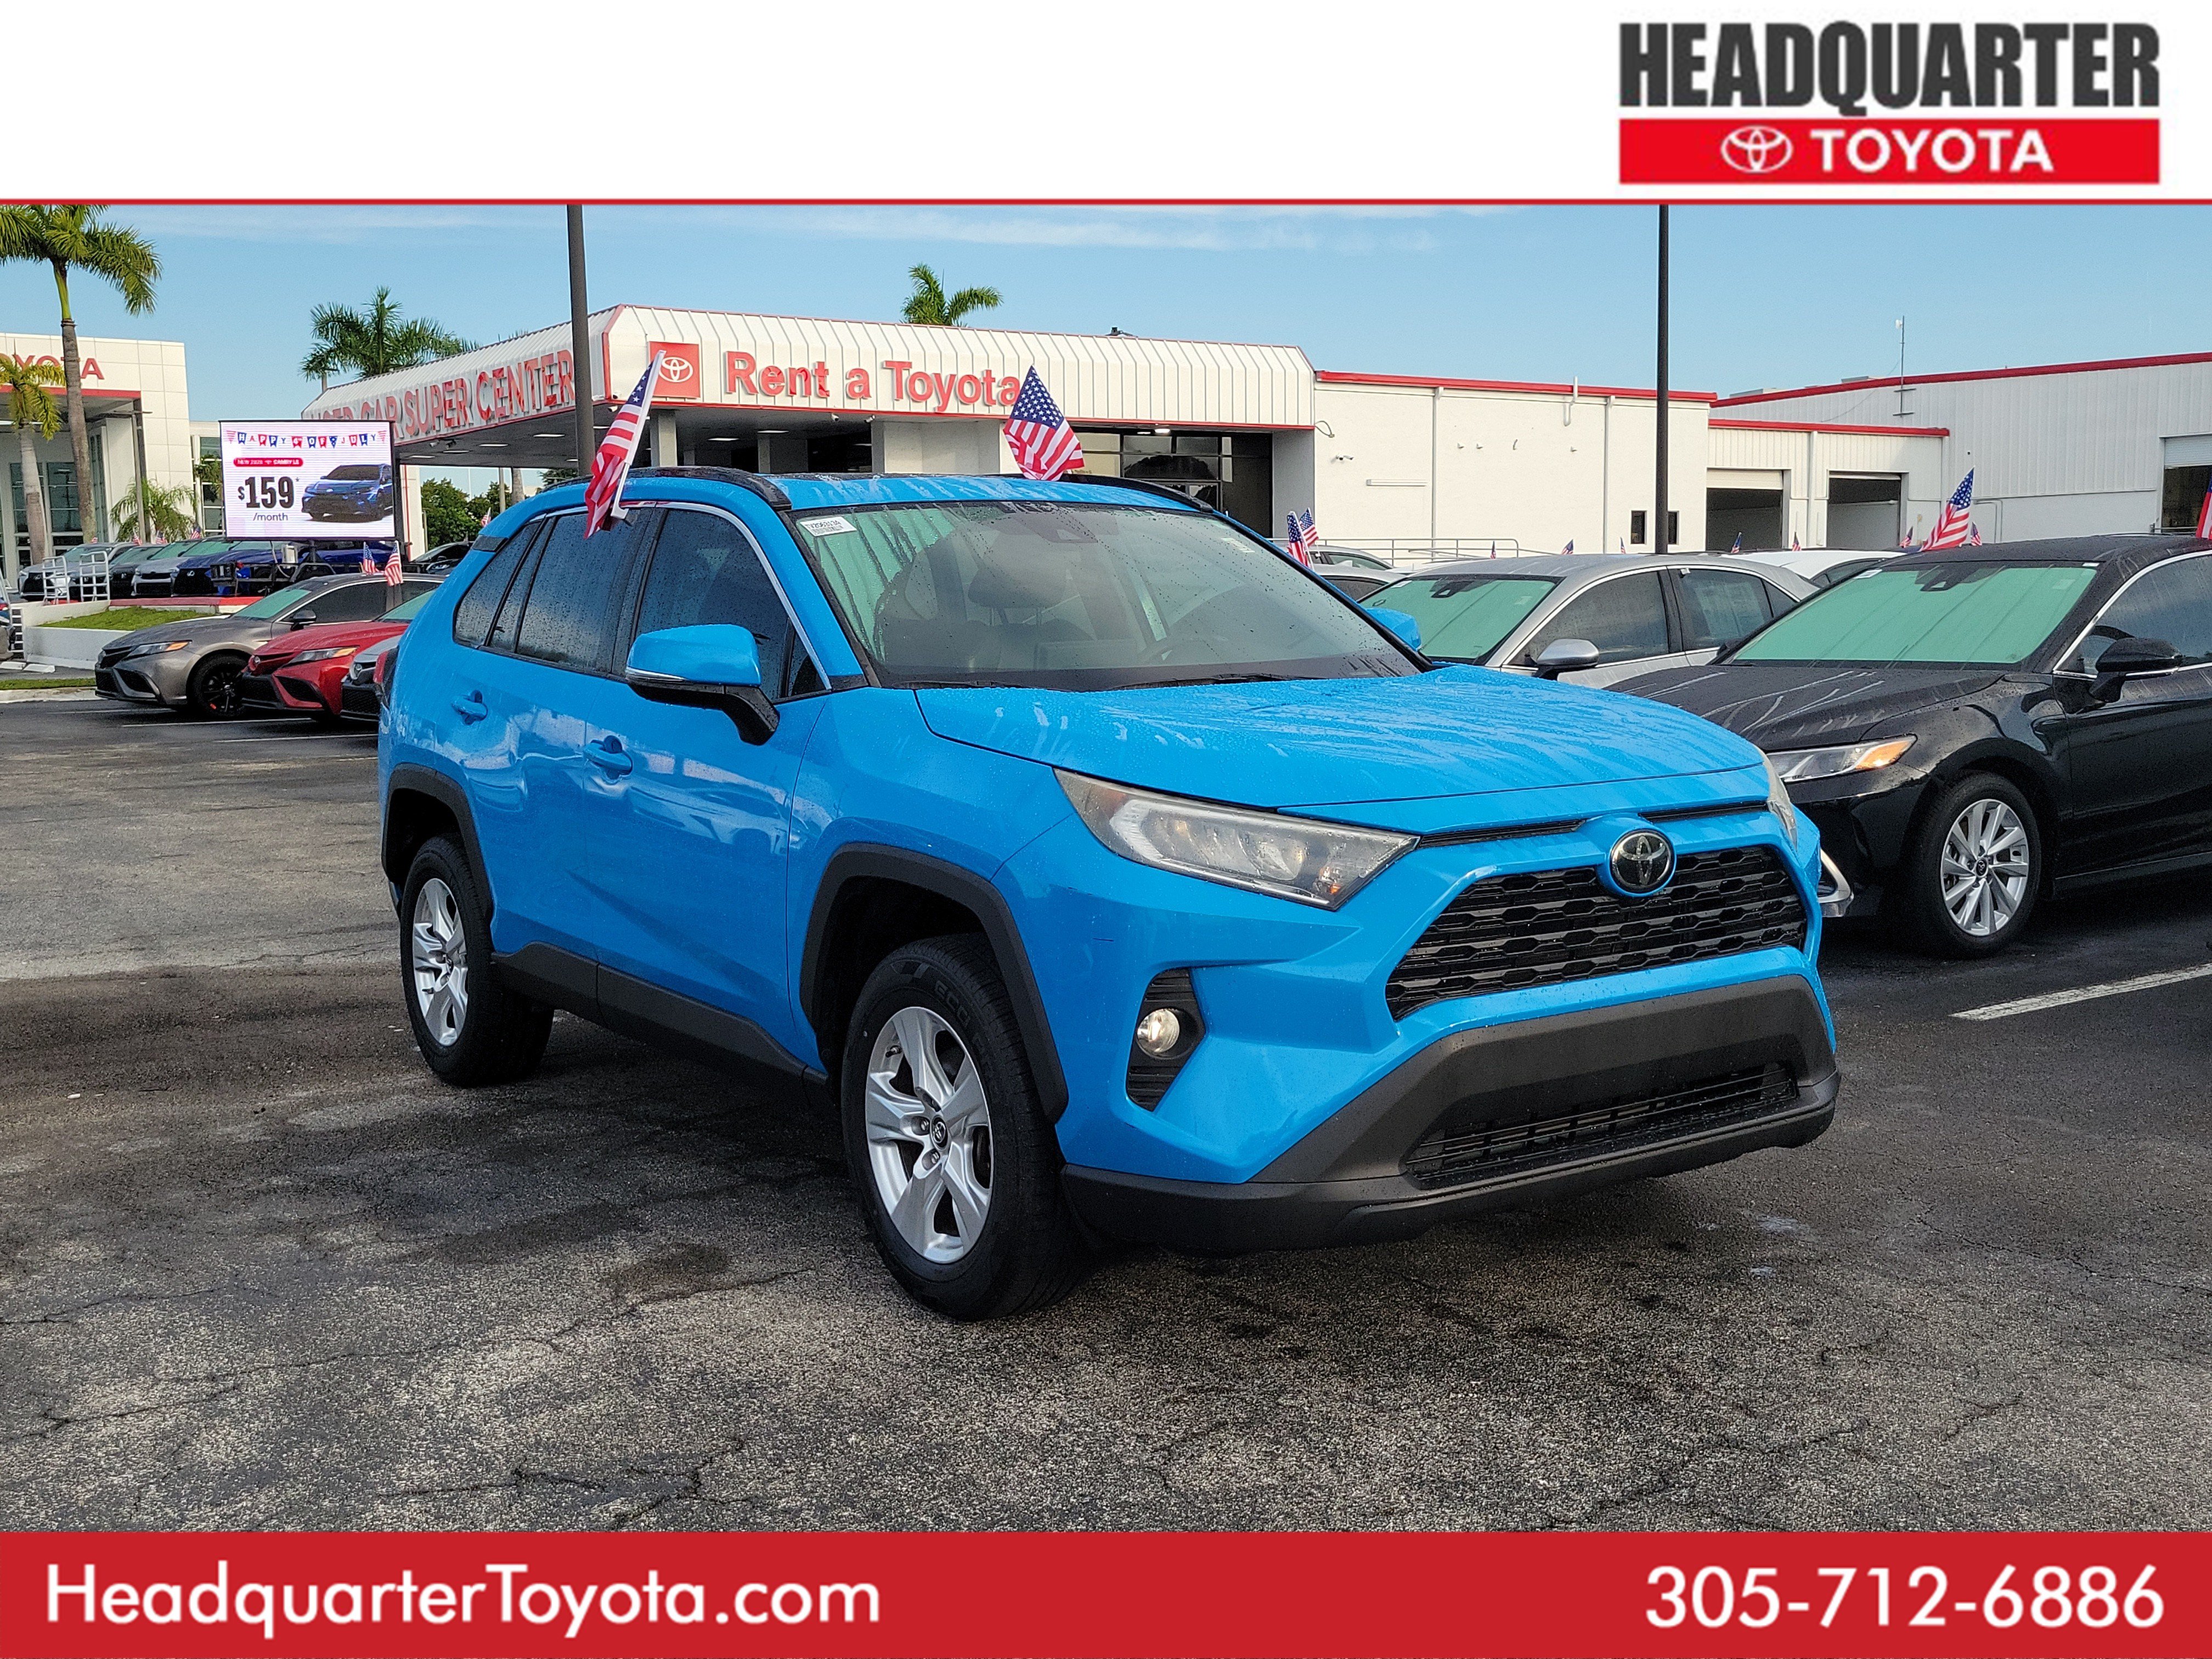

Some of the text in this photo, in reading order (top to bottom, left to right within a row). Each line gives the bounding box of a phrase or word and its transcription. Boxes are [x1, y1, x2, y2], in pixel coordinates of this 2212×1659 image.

[404, 377, 470, 436] SUPER
[477, 349, 575, 420] CENTER
[725, 351, 1020, 413] Rent a Toyota
[238, 433, 286, 444] HAPPY
[341, 433, 376, 444] JULY
[253, 512, 289, 521] /month
